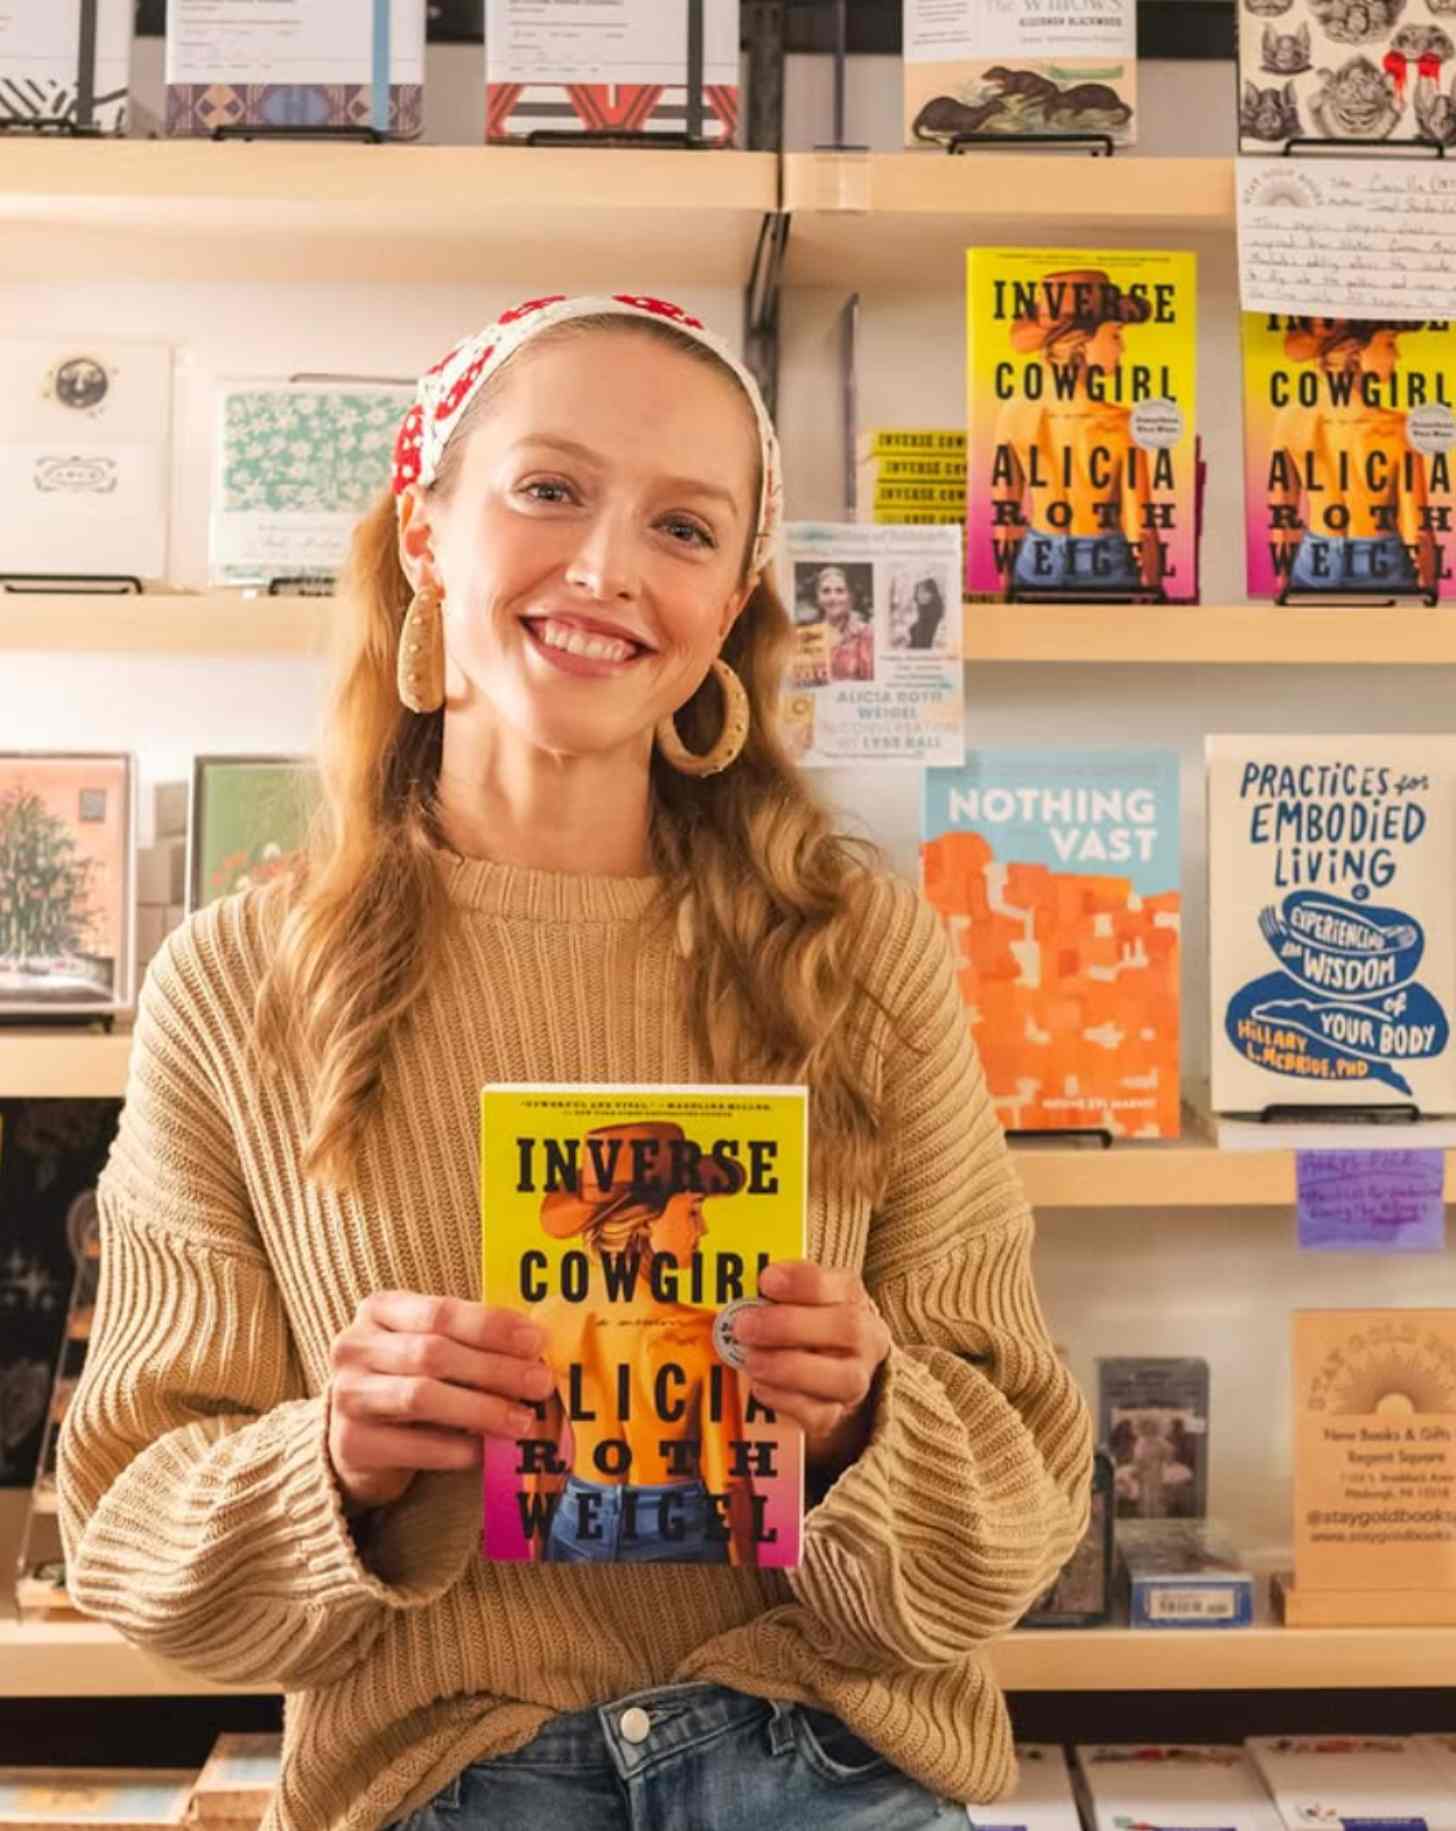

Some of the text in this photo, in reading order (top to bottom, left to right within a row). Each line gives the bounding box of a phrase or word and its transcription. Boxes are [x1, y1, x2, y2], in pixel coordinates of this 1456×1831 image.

[993, 280, 1176, 324] INVERSE
[995, 361, 1177, 403] COWGIRL
[1270, 370, 1452, 408] COWGIRL
[991, 444, 1175, 490] ALICIA
[1267, 449, 1451, 493] ALICIA
[991, 500, 1176, 529] ROTH
[1267, 503, 1453, 532] ROTH
[991, 538, 1176, 577] WEIGEL
[1268, 541, 1453, 579] WEIGEL
[949, 787, 1157, 824] NOTHING
[1048, 826, 1158, 862] VAST
[1319, 1013, 1436, 1055] YOUR BODY
[515, 1136, 779, 1195] INVERSE
[520, 1362, 777, 1424] LICI
[515, 1438, 778, 1478] ROTH
[516, 1491, 778, 1544] WEIGEL
